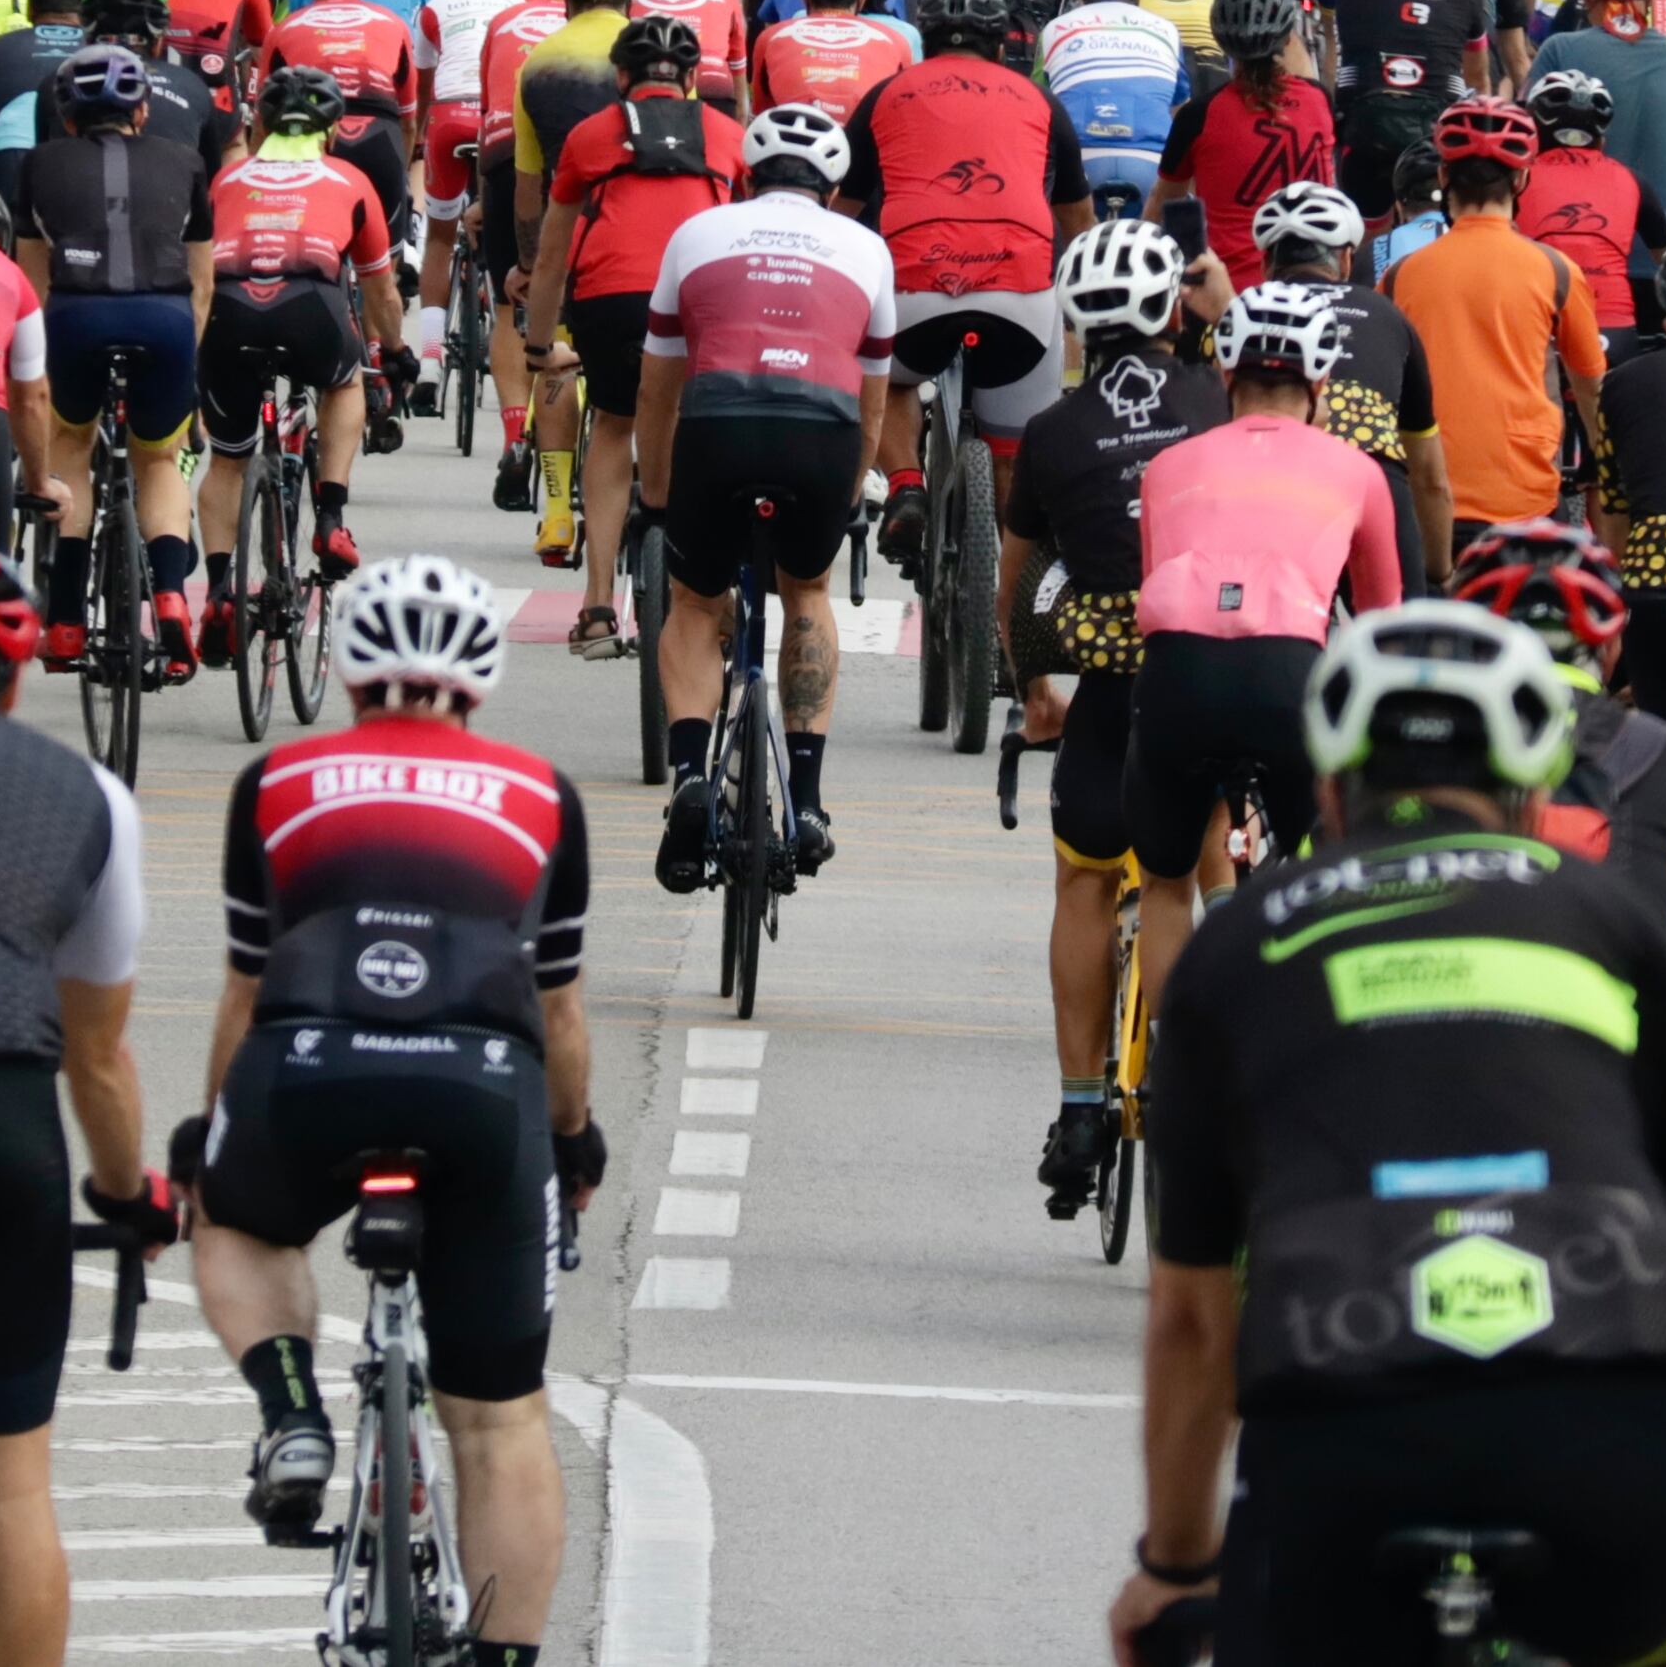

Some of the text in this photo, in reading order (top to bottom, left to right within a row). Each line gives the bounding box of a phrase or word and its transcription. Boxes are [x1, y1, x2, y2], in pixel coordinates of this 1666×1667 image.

[1089, 39, 1161, 56] GRANADA
[746, 271, 812, 286] CROWN
[1096, 424, 1189, 450] The TreeHouse
[311, 764, 509, 812] BIKE BOX
[361, 958, 420, 979] BIKE BOX
[351, 1033, 460, 1054] SABADELL
